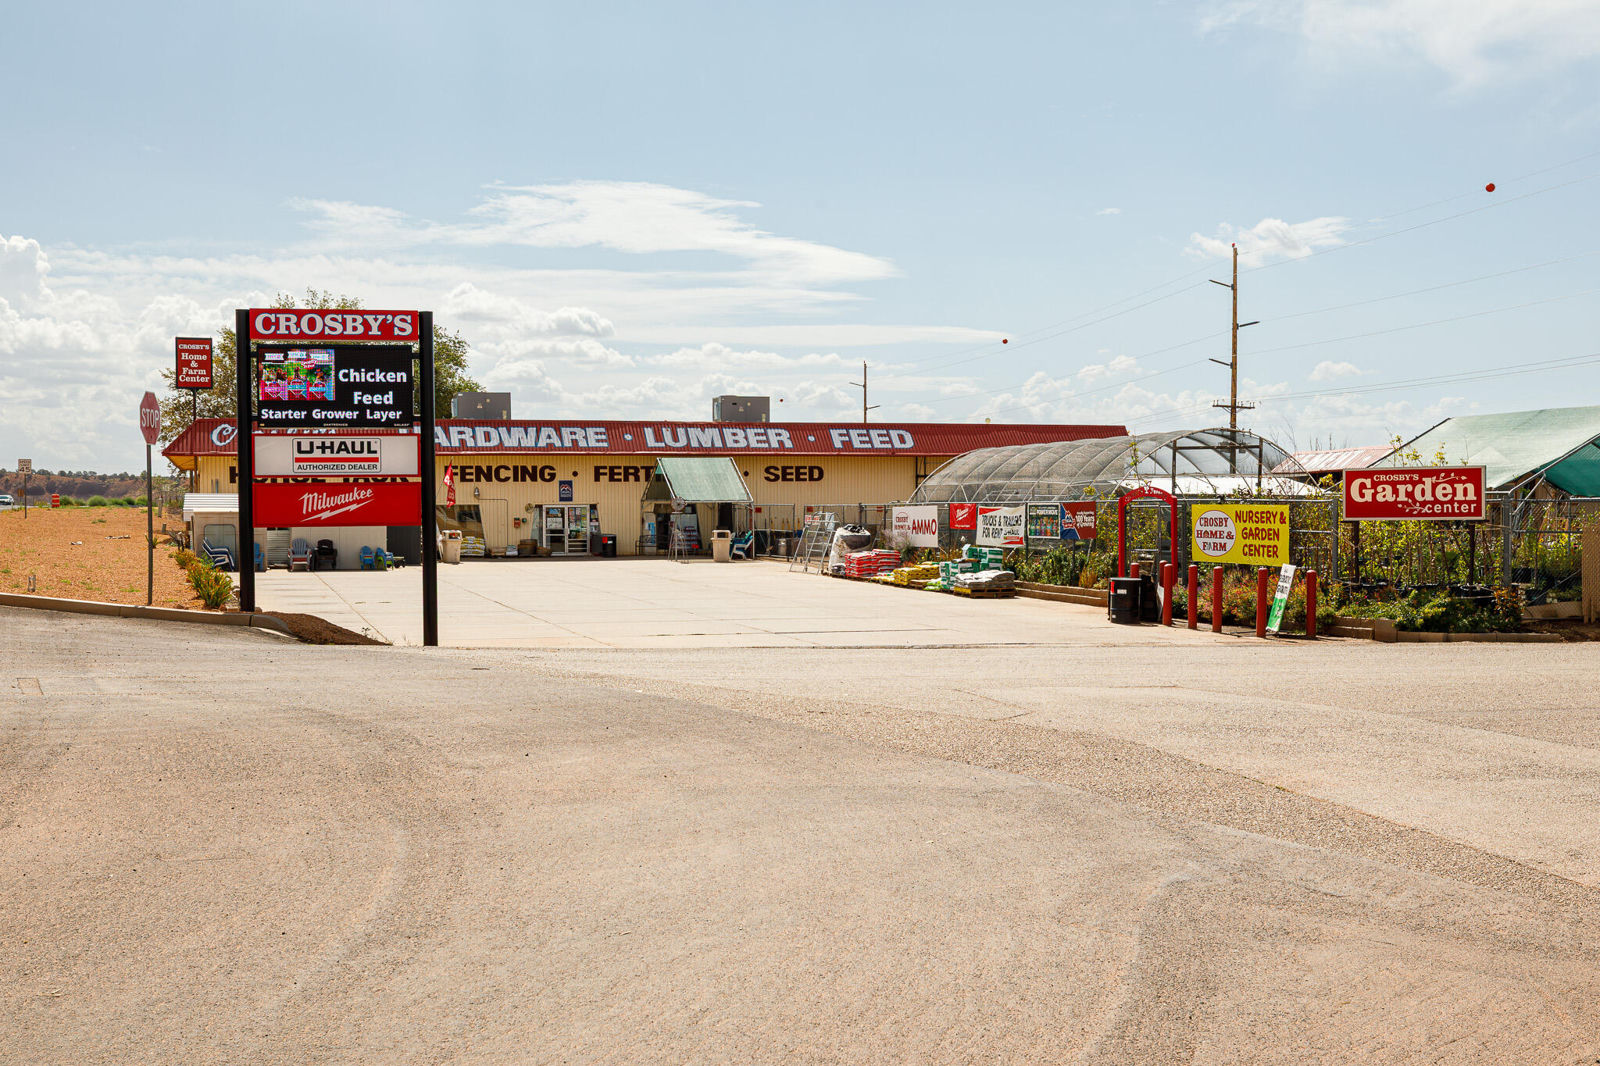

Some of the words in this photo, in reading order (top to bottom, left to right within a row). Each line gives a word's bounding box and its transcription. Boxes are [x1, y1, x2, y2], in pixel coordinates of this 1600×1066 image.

[255, 312, 413, 336] CROSBY'S
[181, 352, 207, 360] Home
[182, 367, 207, 375] Farm
[338, 368, 407, 383] Chicken
[179, 374, 210, 383] Center
[353, 391, 394, 405] Feed
[141, 408, 160, 429] STOP
[261, 408, 307, 419] Starter
[312, 408, 359, 419] Grower
[366, 409, 402, 422] Layer
[434, 426, 609, 448] ARDWARE
[643, 426, 794, 449] LUMBER
[829, 428, 915, 449] FEED
[296, 440, 378, 454] U-HAUL
[348, 463, 378, 471] DEALER
[764, 465, 824, 483] SEED
[1373, 474, 1419, 482] CROSBY'S
[1350, 476, 1477, 503] Garden
[298, 487, 374, 515] Milwaukee
[1425, 502, 1477, 513] center
[1199, 517, 1229, 527] CROSBY
[1235, 510, 1278, 525] NURSERY
[1279, 511, 1287, 525] &
[911, 518, 938, 536] AMMO
[1225, 530, 1235, 540] &
[1241, 527, 1280, 542] GARDEN
[1202, 541, 1227, 551] FARM
[1242, 544, 1279, 559] CENTER
